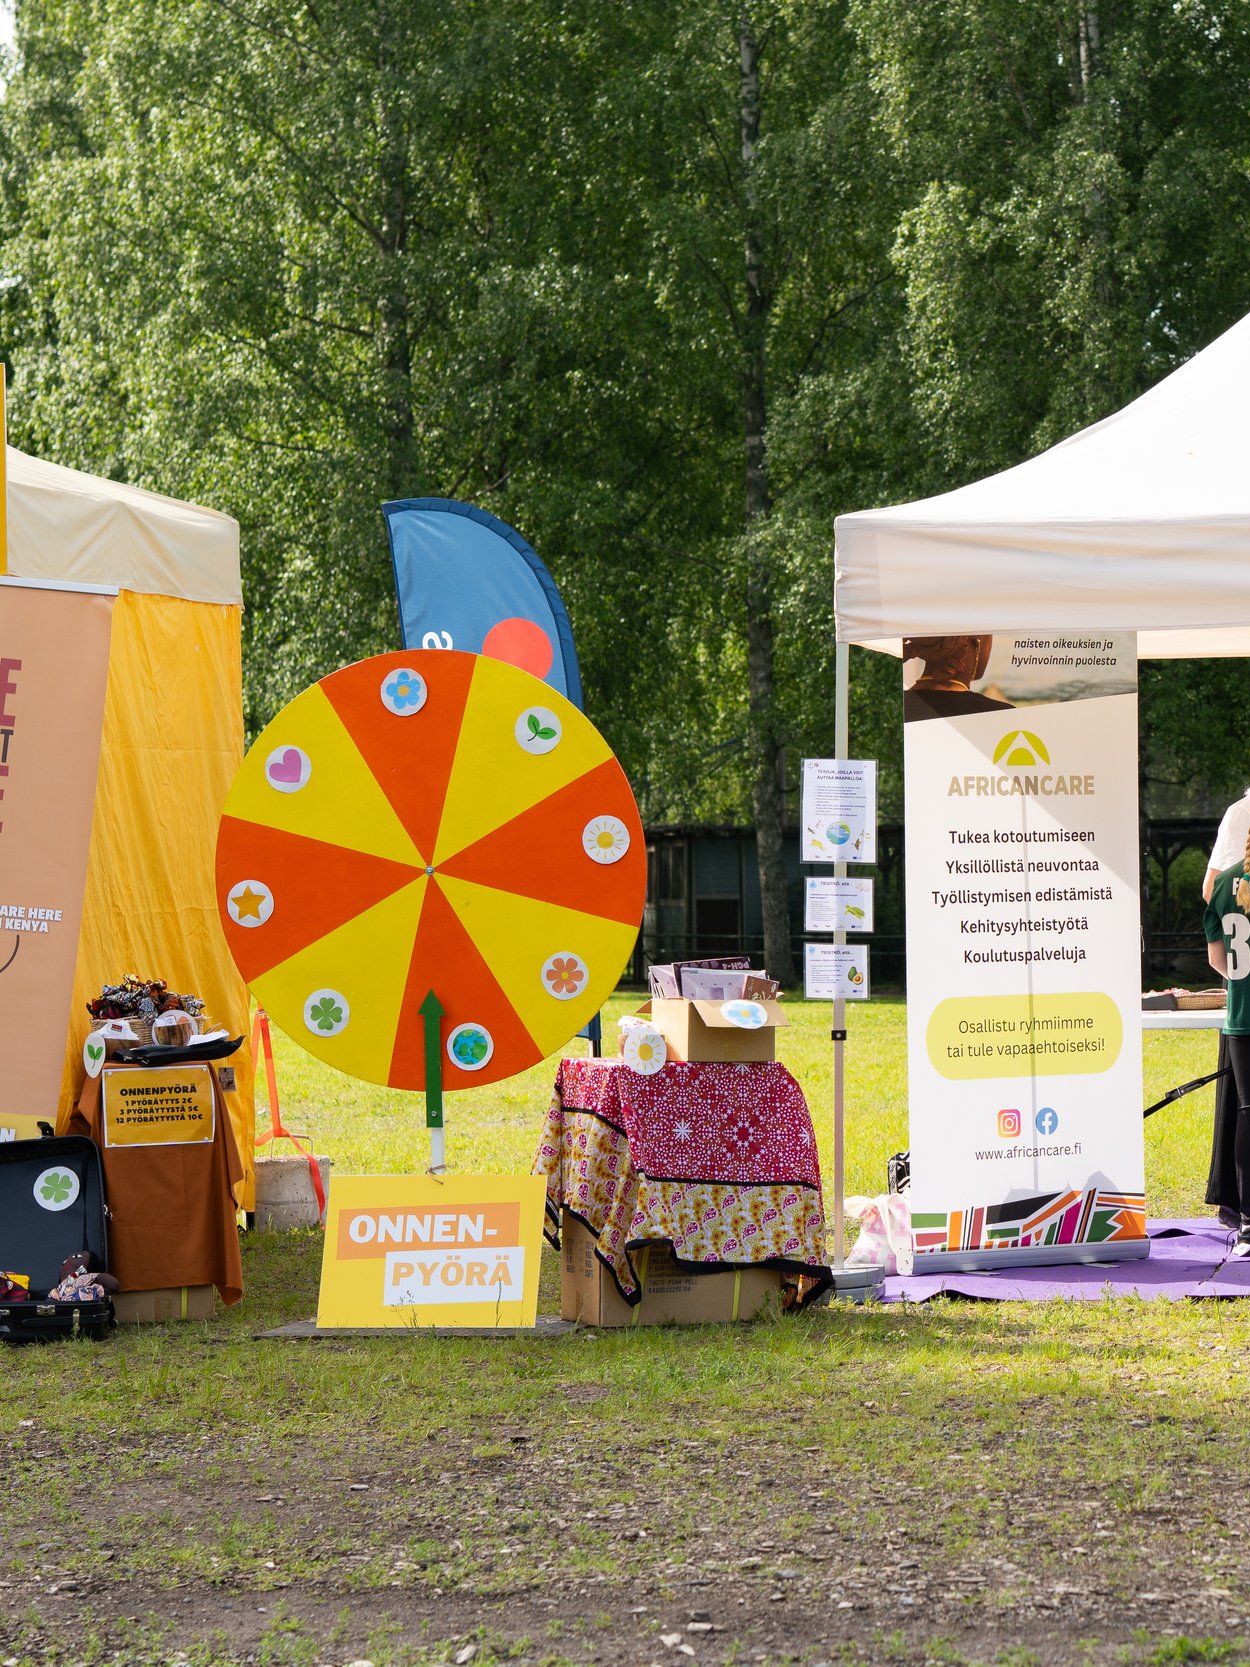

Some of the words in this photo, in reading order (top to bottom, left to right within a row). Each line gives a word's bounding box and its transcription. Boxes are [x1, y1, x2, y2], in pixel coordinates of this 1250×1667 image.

[1014, 638, 1050, 649] naisten
[1052, 638, 1102, 650] oikeuksien
[1101, 639, 1114, 652] ja
[1011, 654, 1074, 667] hyvinvoinnin
[1075, 655, 1117, 668] puolesta
[947, 775, 1096, 797] AFRICANCARE
[949, 830, 990, 844] Tukea
[993, 828, 1096, 844] kotoutumiseen
[946, 859, 1025, 874] Yksillöllistä
[1027, 859, 1100, 873] neuvontaa
[932, 888, 1032, 908] Työllistymisen
[1035, 887, 1113, 902] edistämistä
[0, 905, 26, 918] ARE
[28, 907, 63, 922] HERE
[5, 918, 49, 933] KENYA
[960, 917, 1089, 936] Kehitysyhteistyötä
[964, 946, 1087, 965] Koulutuspalveluja
[958, 1018, 1016, 1034] Osallistu
[1019, 1016, 1094, 1035] ryhmiimme
[947, 1044, 964, 1058] tai
[967, 1042, 994, 1057] tule
[997, 1038, 1105, 1058] vapaaehtoiseksi!
[120, 1083, 198, 1096] ONNENPYÖRÄ
[126, 1105, 186, 1115] PYÖRÄYTYSTÄ
[131, 1097, 180, 1107] PYÖRÄYTYS
[126, 1113, 186, 1124] PYÖRÄYTYSTÄ
[975, 1142, 1083, 1161] www.africancare.fi
[348, 1214, 498, 1244] ONNEN-
[391, 1255, 513, 1287] PYÖRÄ
